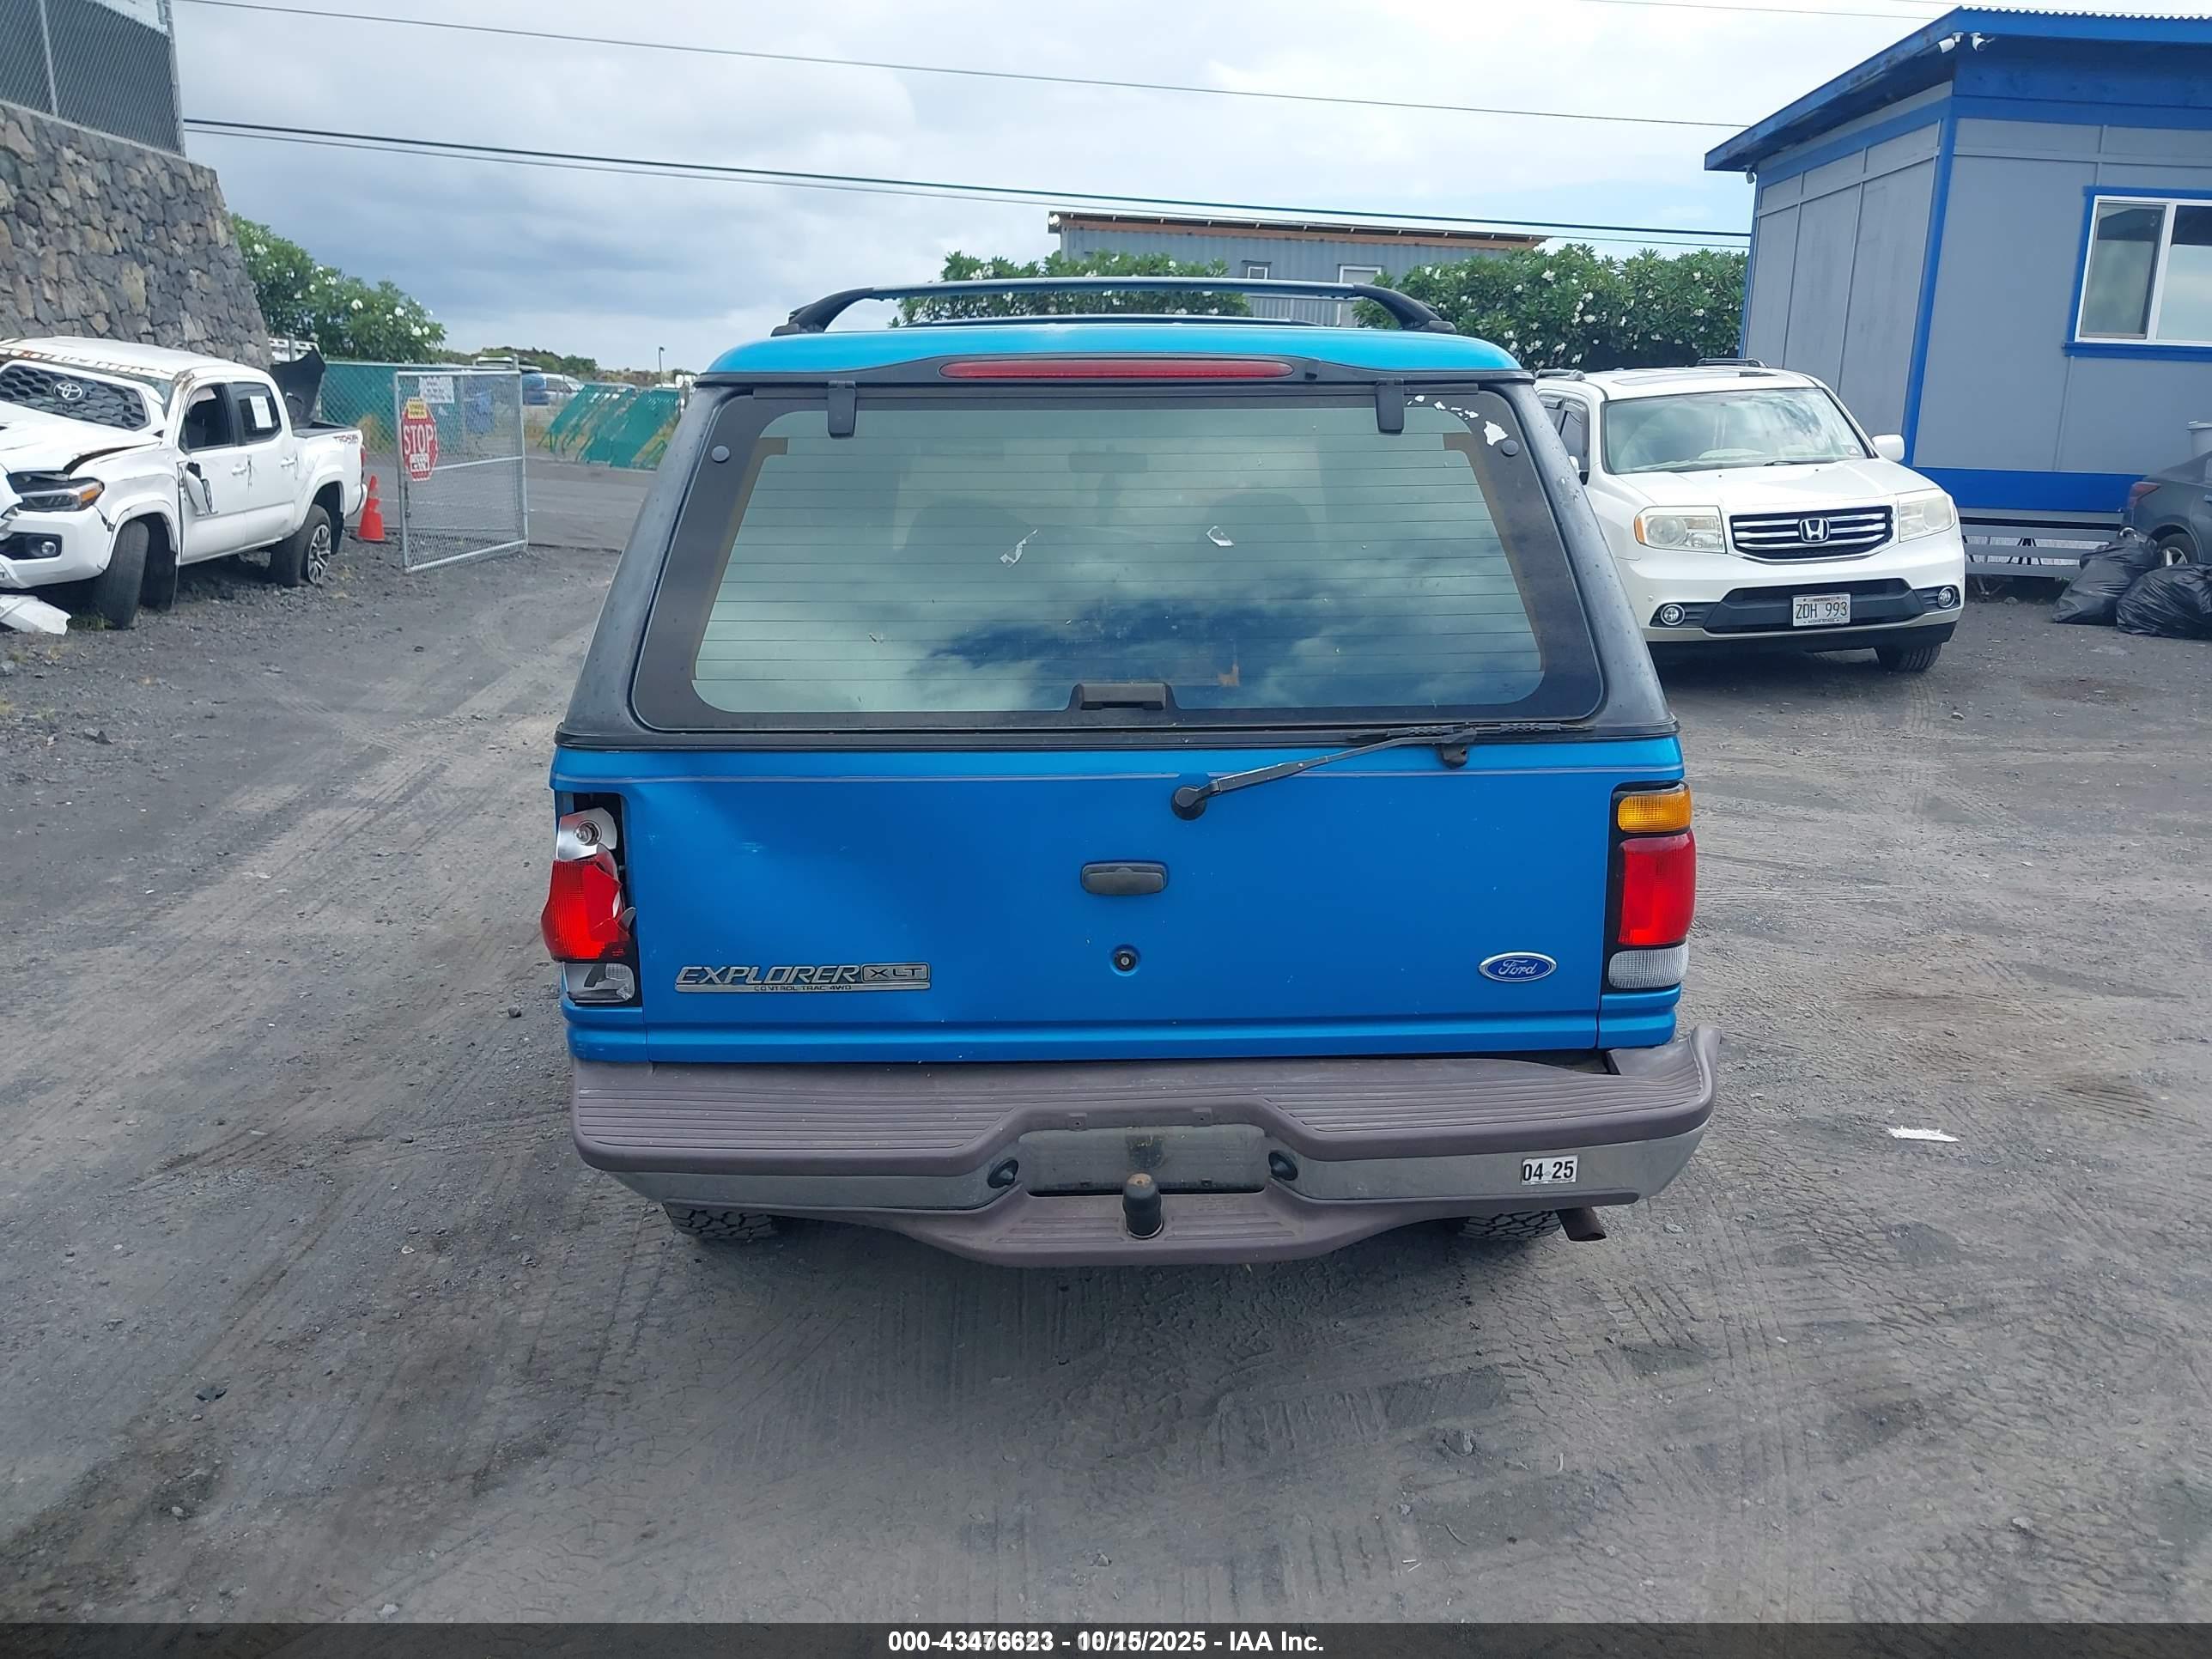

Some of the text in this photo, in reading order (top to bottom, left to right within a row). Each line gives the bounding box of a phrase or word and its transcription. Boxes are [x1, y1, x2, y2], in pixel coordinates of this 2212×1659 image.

[403, 424, 434, 455] STOP
[1796, 601, 1848, 619] ZDH 993
[676, 965, 923, 984] EXPLORER XLT
[1498, 959, 1538, 975] Ford
[1522, 1160, 1574, 1182] 04 25
